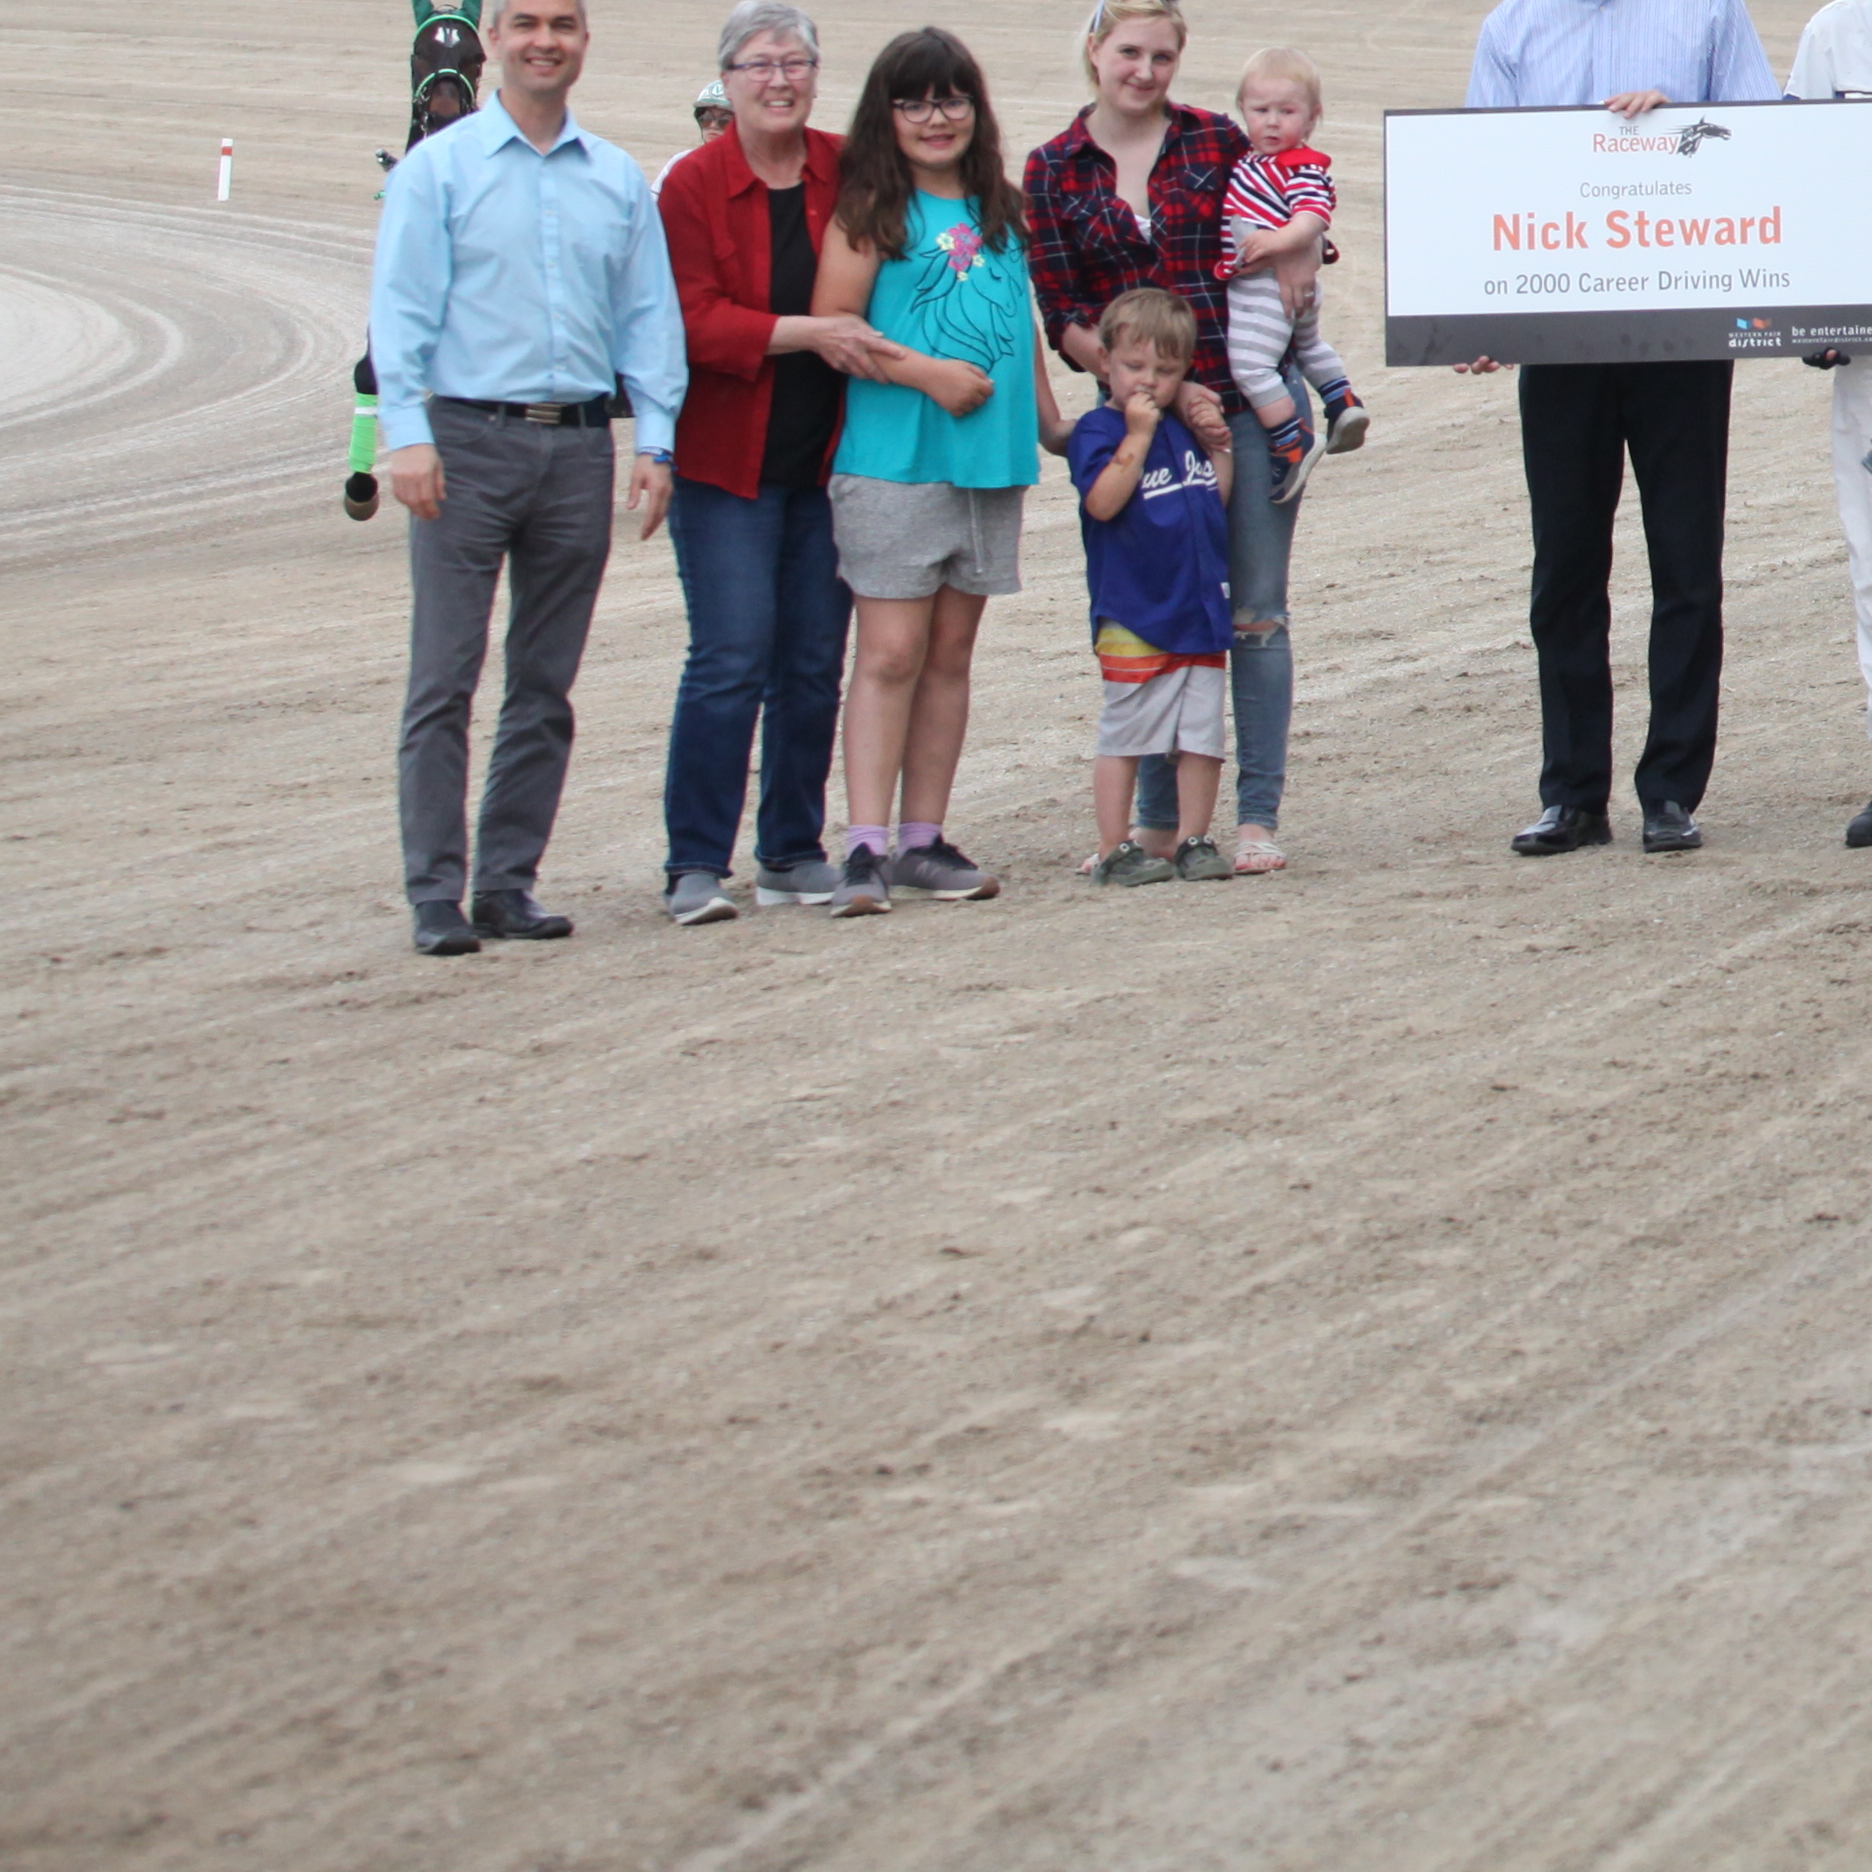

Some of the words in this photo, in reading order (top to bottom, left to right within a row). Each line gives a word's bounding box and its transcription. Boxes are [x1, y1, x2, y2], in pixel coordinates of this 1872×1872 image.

[1618, 126, 1639, 135] THE
[1593, 133, 1679, 155] Raceway
[1579, 180, 1693, 200] Congratulates
[1493, 211, 1589, 251] Nick
[1605, 205, 1782, 249] Steward
[1484, 278, 1508, 295] on
[1516, 273, 1571, 294] 2000
[1578, 272, 1650, 293] Career
[1658, 269, 1733, 292] Driving
[1739, 268, 1791, 289] Wins
[1792, 326, 1806, 337] be
[1728, 337, 1782, 348] district
